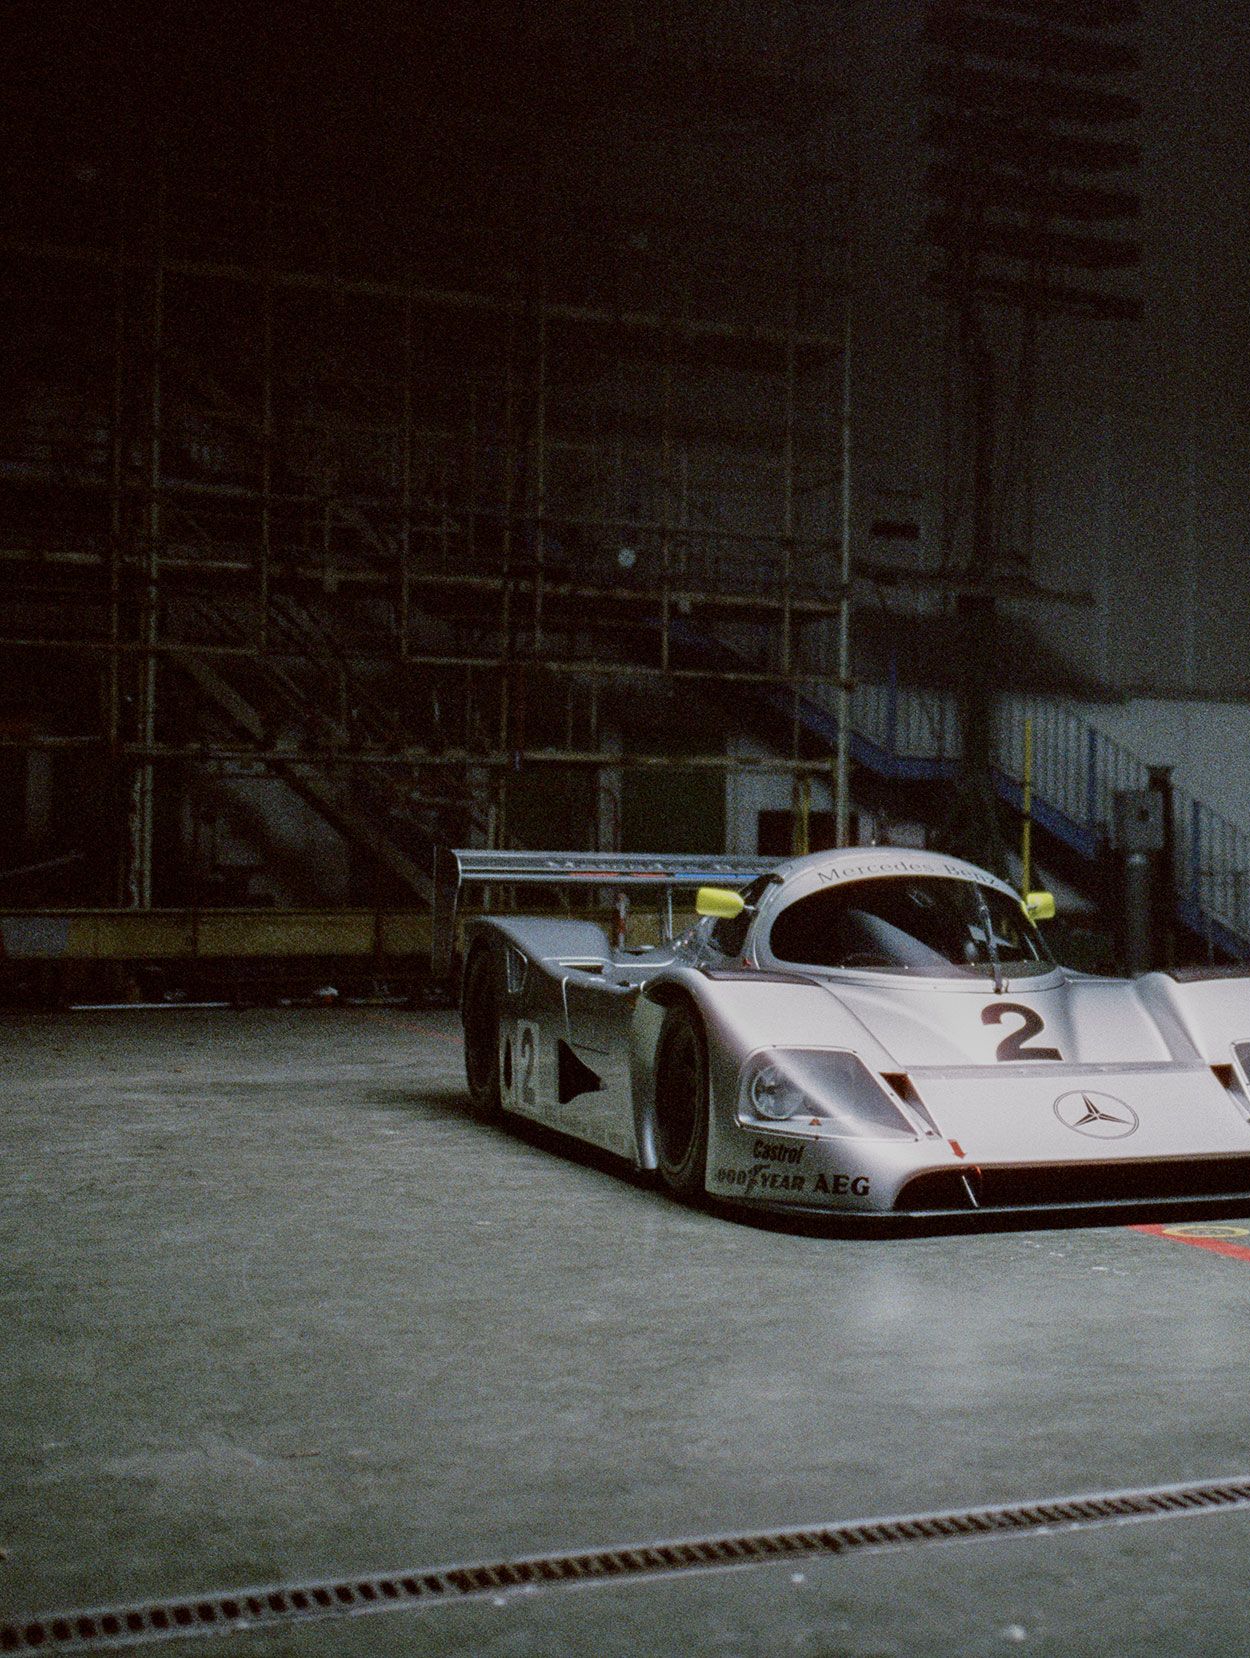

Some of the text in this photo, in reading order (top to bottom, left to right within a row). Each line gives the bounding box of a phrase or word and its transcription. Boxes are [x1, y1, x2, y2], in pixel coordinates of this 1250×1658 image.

[981, 1002, 1063, 1062] 2
[753, 1139, 806, 1164] Castrol
[814, 1173, 870, 1196] AEG
